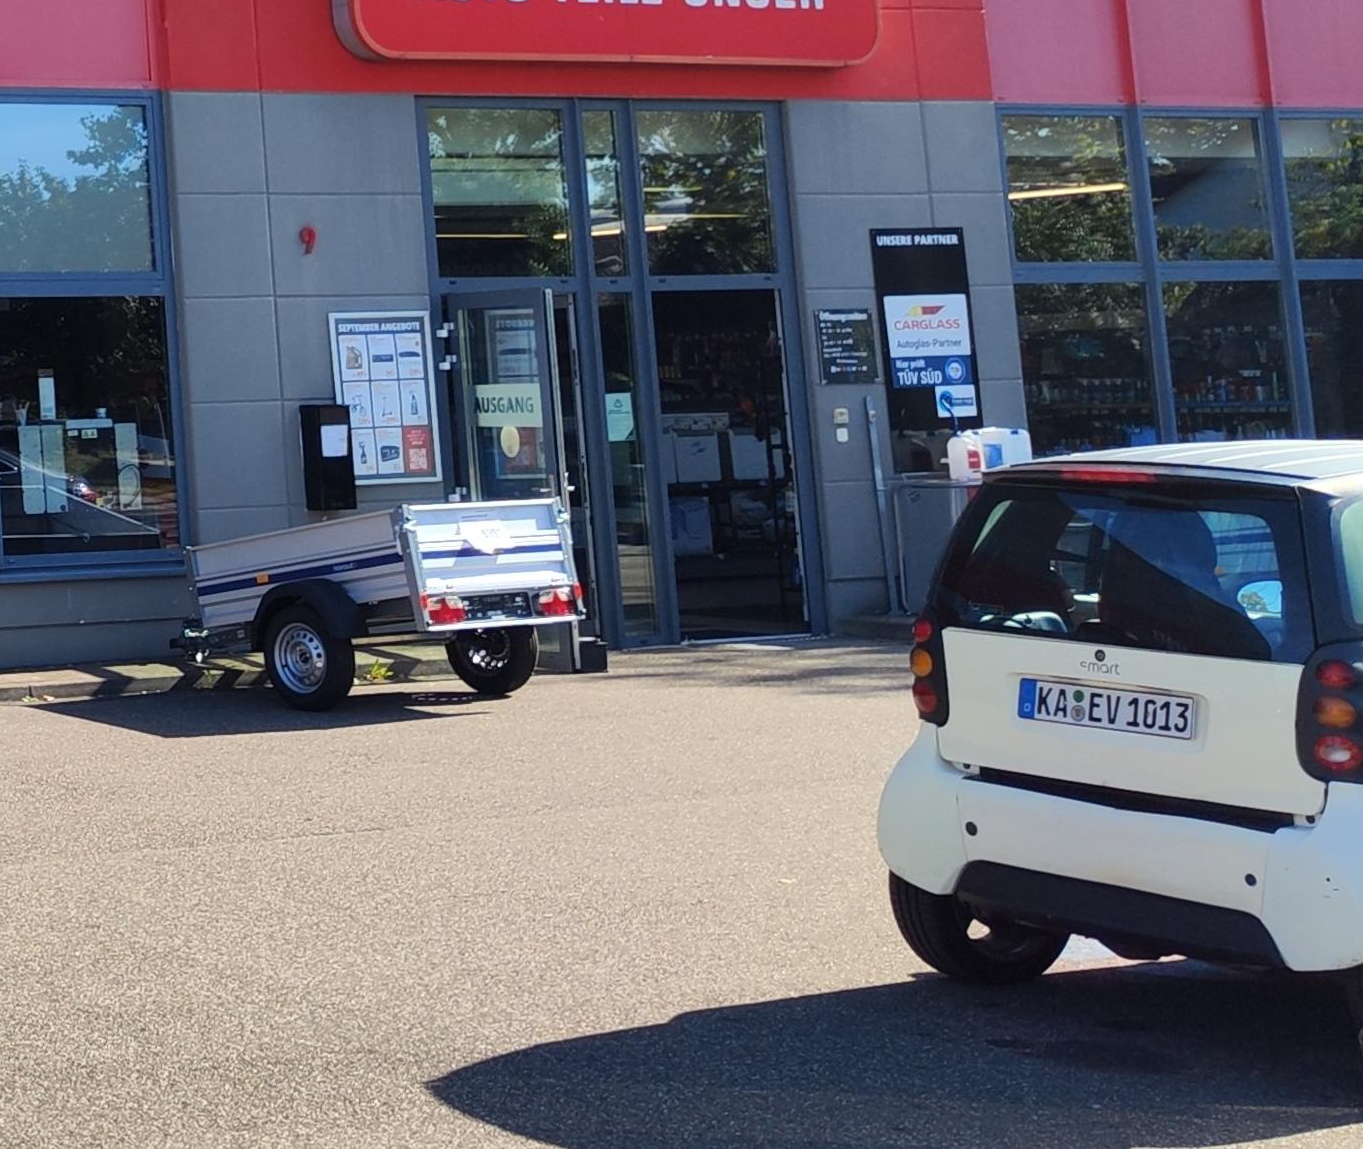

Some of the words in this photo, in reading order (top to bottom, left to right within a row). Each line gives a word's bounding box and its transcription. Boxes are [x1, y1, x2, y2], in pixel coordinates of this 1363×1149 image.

[876, 235, 913, 246] UNSERE
[914, 233, 959, 245] PARTNER
[893, 319, 960, 330] CARGLASS
[897, 369, 918, 385] TÜV
[920, 368, 943, 384] SÜD
[474, 396, 534, 414] AUSGANG
[1037, 686, 1067, 718] KA
[1088, 692, 1121, 725] EV
[1126, 697, 1189, 733] 1013
